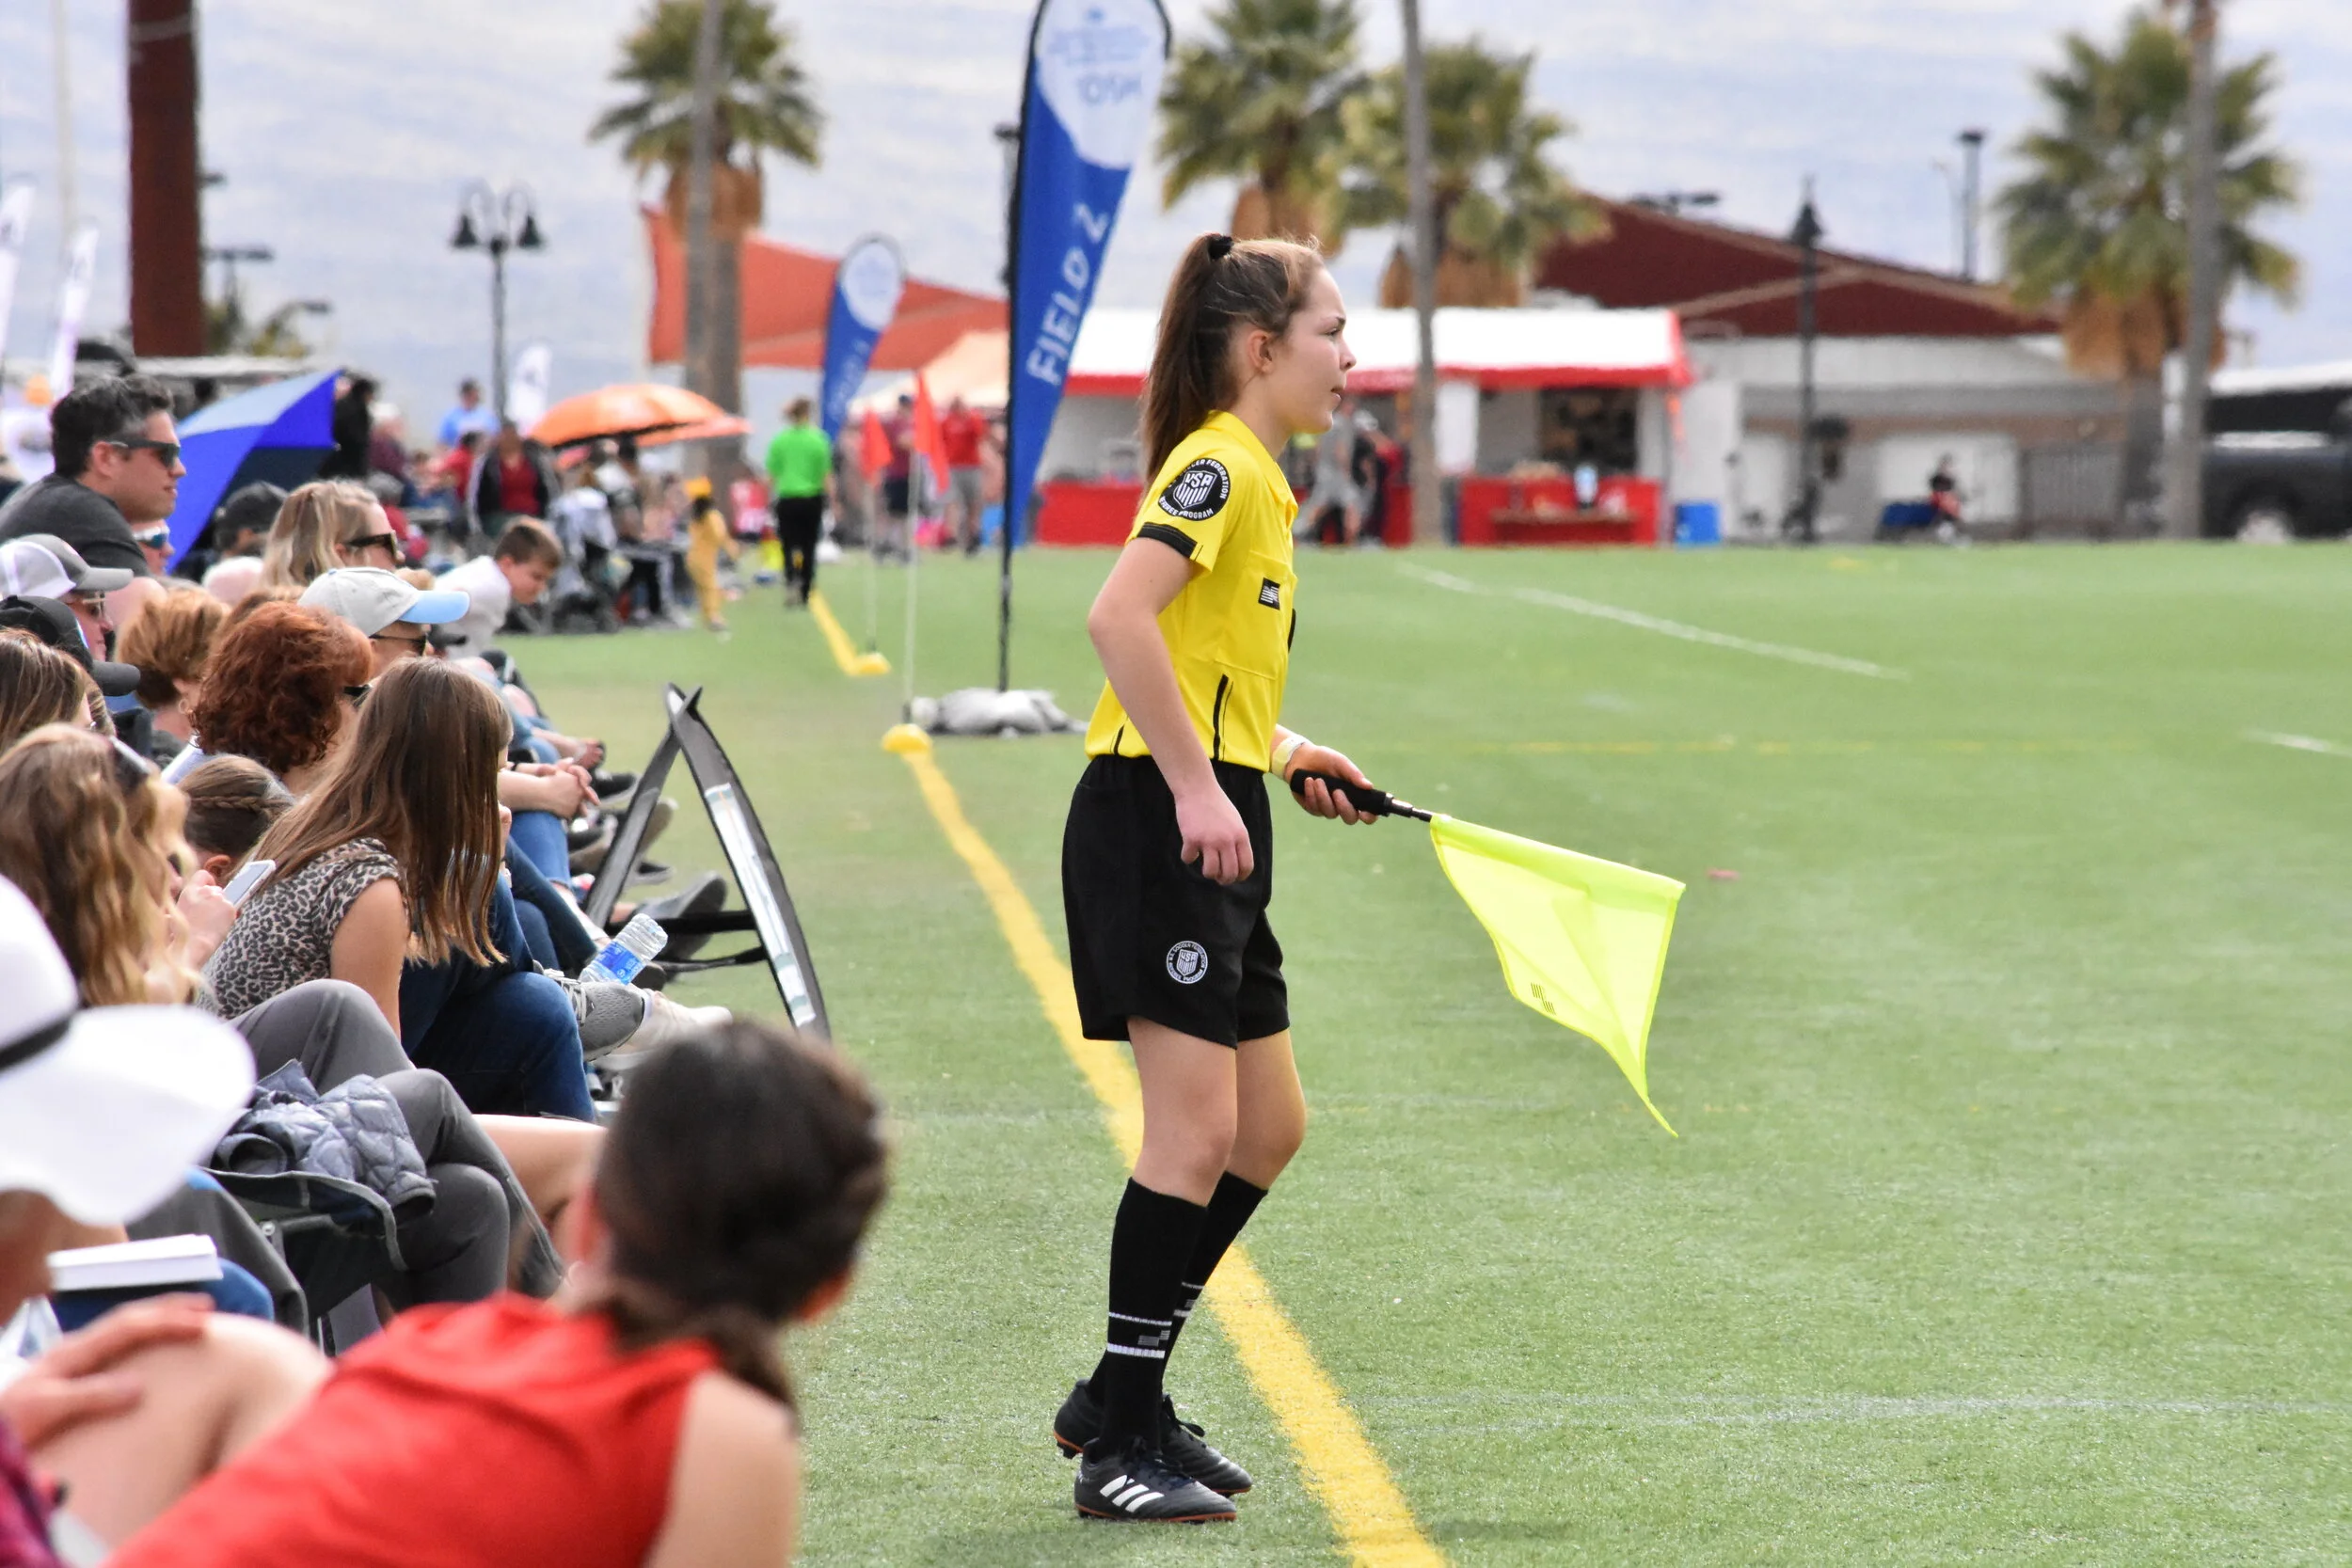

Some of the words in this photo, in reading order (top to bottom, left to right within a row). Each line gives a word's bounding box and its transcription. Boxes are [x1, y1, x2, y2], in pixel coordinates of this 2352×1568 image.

[1025, 246, 1090, 386] FIELD
[1185, 472, 1214, 487] USA
[1206, 459, 1229, 499] FEDERATION
[1178, 508, 1214, 519] PROGRAM
[1181, 952, 1198, 961] USA
